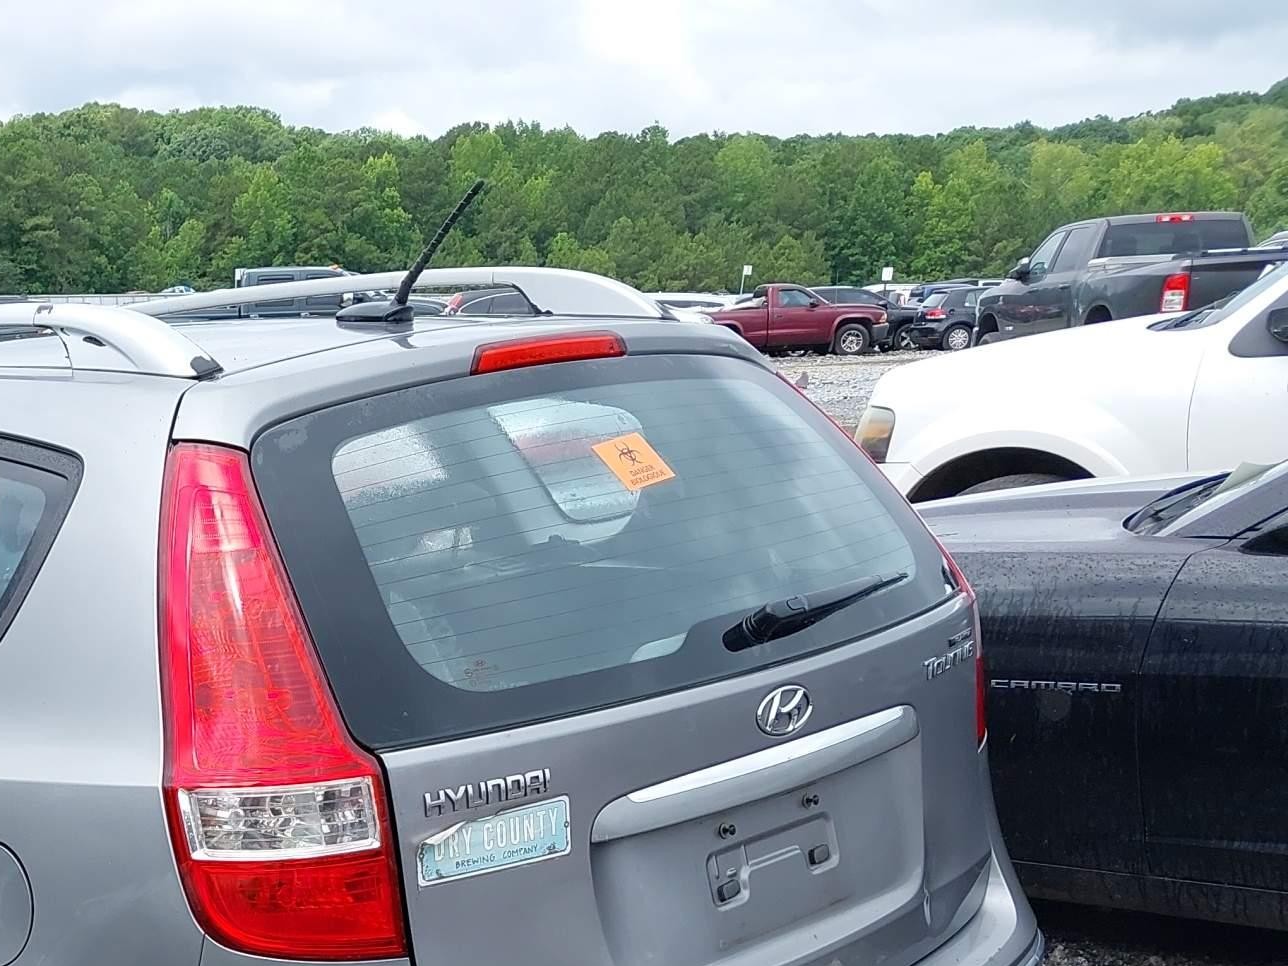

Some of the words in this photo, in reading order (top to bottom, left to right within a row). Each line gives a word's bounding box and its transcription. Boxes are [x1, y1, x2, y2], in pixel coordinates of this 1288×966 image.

[990, 679, 1121, 692] CAMARO
[424, 768, 551, 817] HYUNDAI
[483, 807, 559, 851] COUNTY
[455, 853, 496, 869] BREWING
[502, 844, 539, 859] COMPANY
